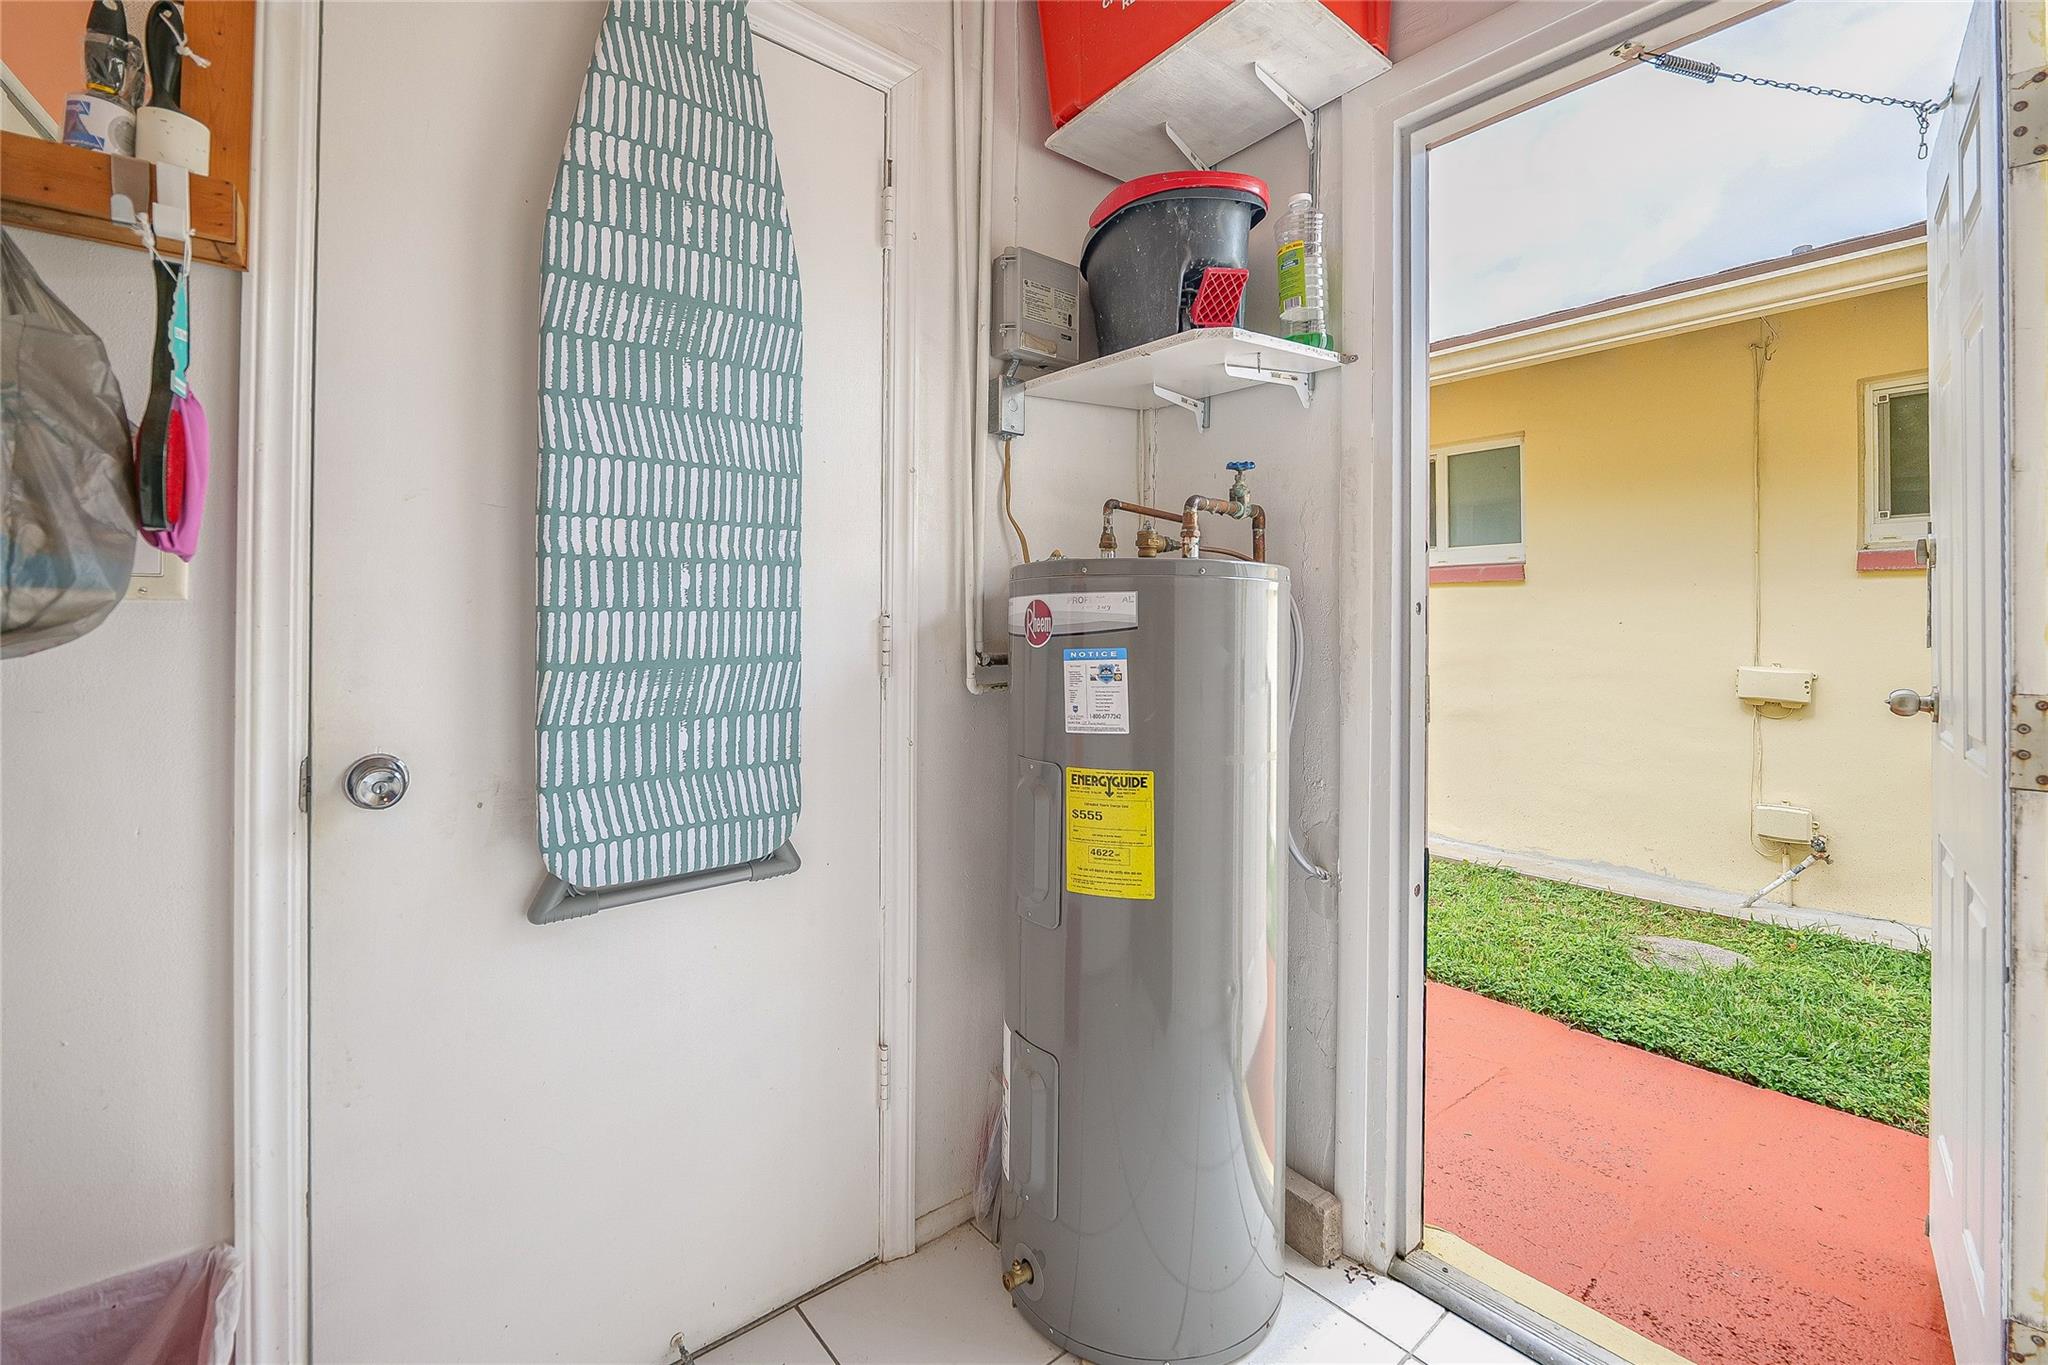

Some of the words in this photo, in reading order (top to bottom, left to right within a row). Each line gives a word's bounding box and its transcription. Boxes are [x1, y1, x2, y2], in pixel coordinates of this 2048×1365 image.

[1026, 600, 1051, 639] Rheem
[1071, 774, 1148, 788] ENERGYGUIDE
[1072, 808, 1103, 821] $555
[1090, 848, 1114, 857] 4622
